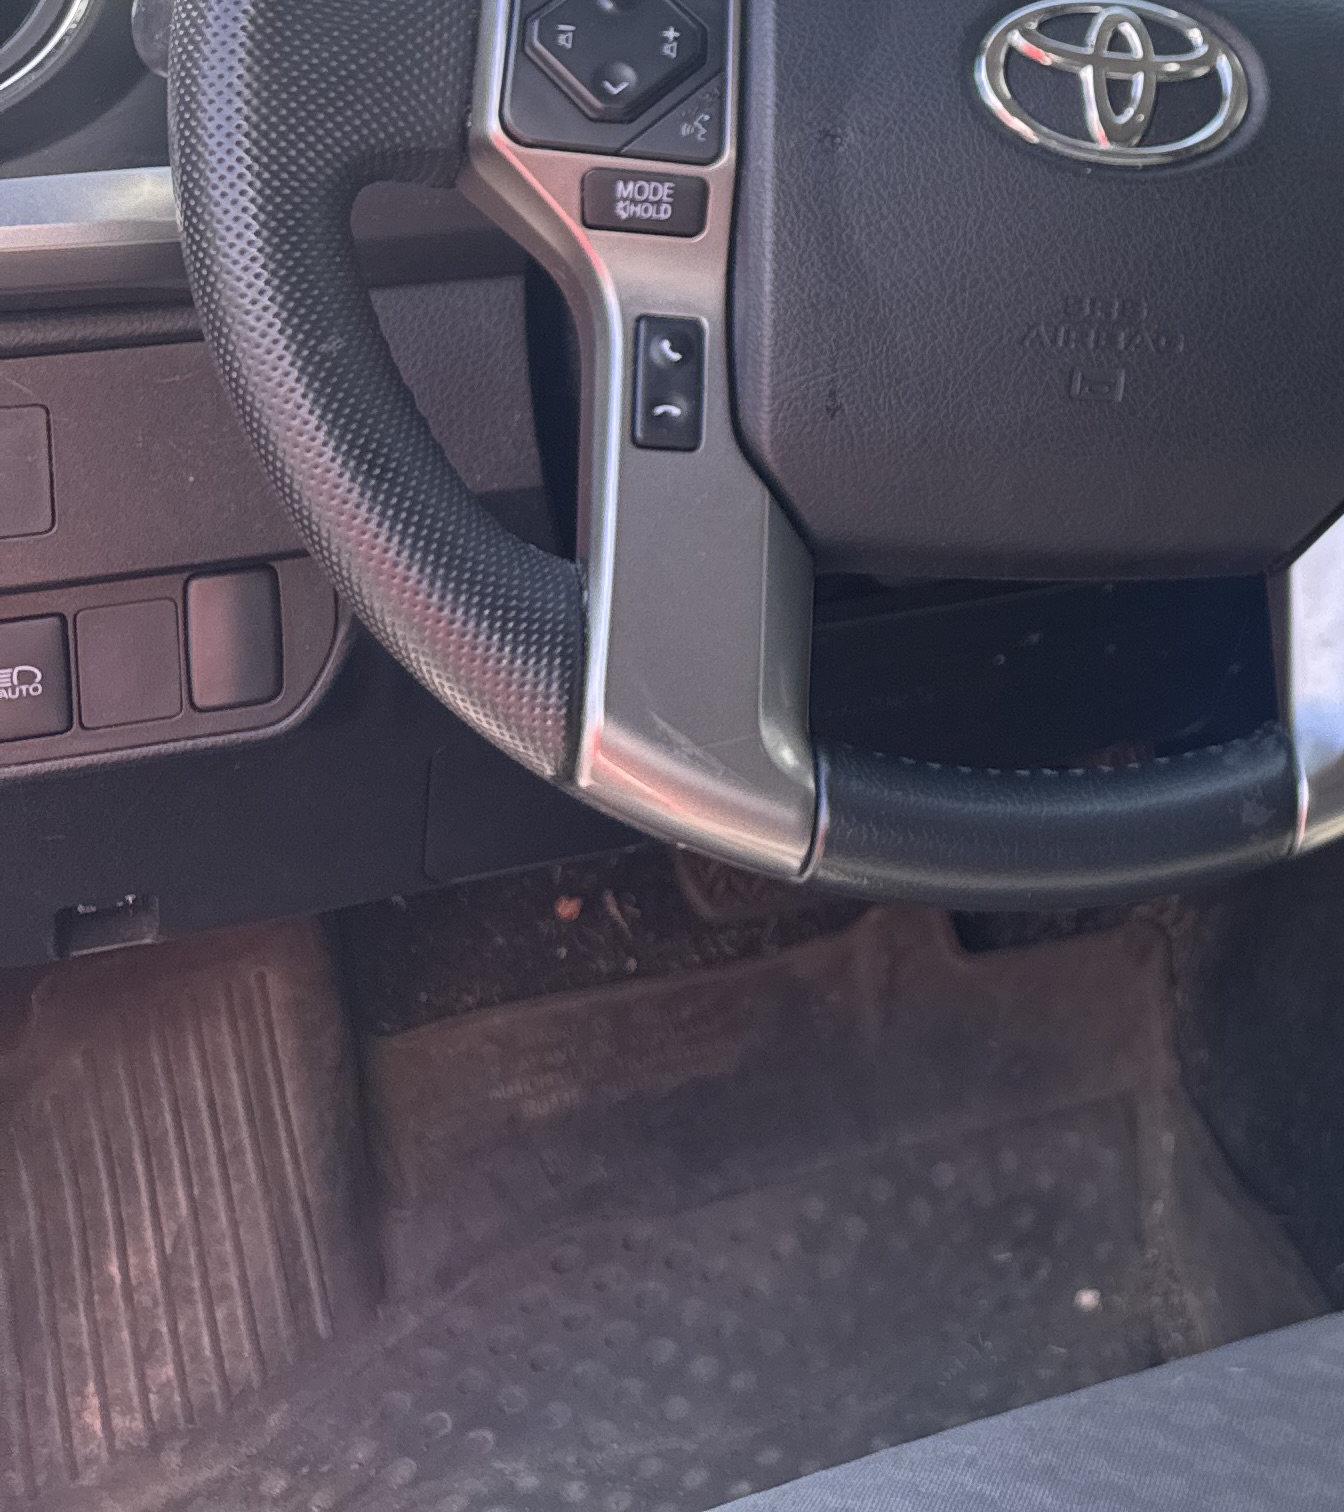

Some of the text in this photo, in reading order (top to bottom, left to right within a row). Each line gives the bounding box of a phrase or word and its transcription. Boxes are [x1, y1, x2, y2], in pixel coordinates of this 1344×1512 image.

[615, 180, 676, 203] MODE
[629, 201, 672, 220] HOLD
[0, 683, 42, 700] AUTO
